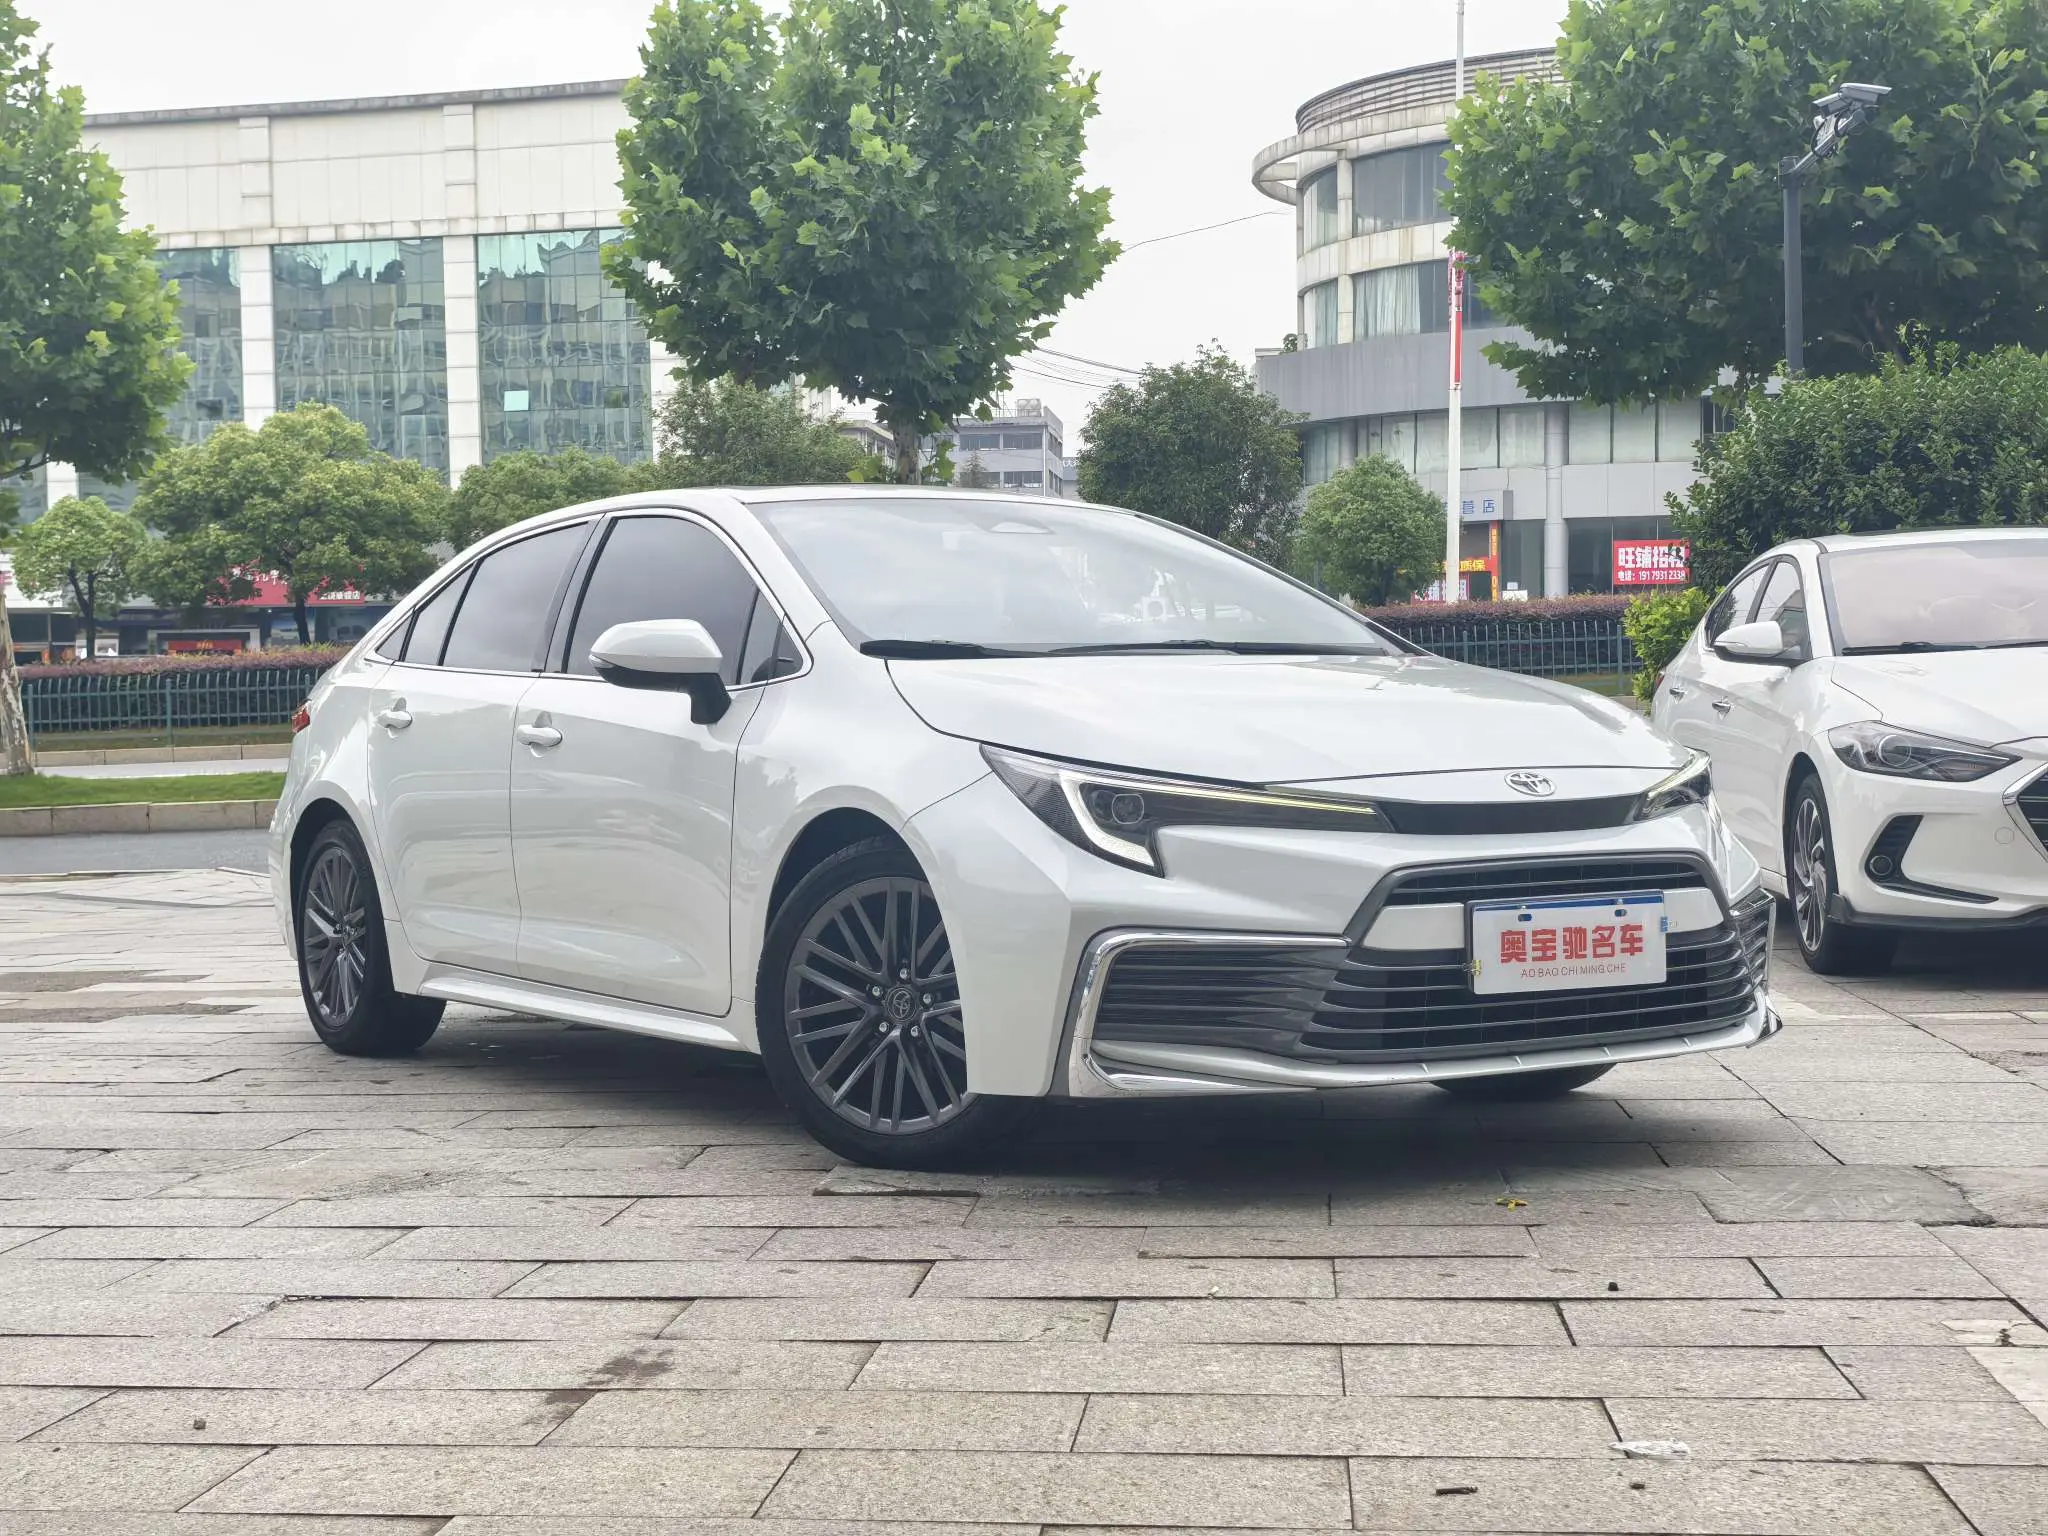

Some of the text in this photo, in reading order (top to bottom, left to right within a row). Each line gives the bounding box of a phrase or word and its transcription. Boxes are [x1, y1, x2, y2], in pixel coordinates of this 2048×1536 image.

[1500, 923, 1644, 964] 奥宝驰名车
[1521, 963, 1626, 978] AO BAO CHI MING CHE
